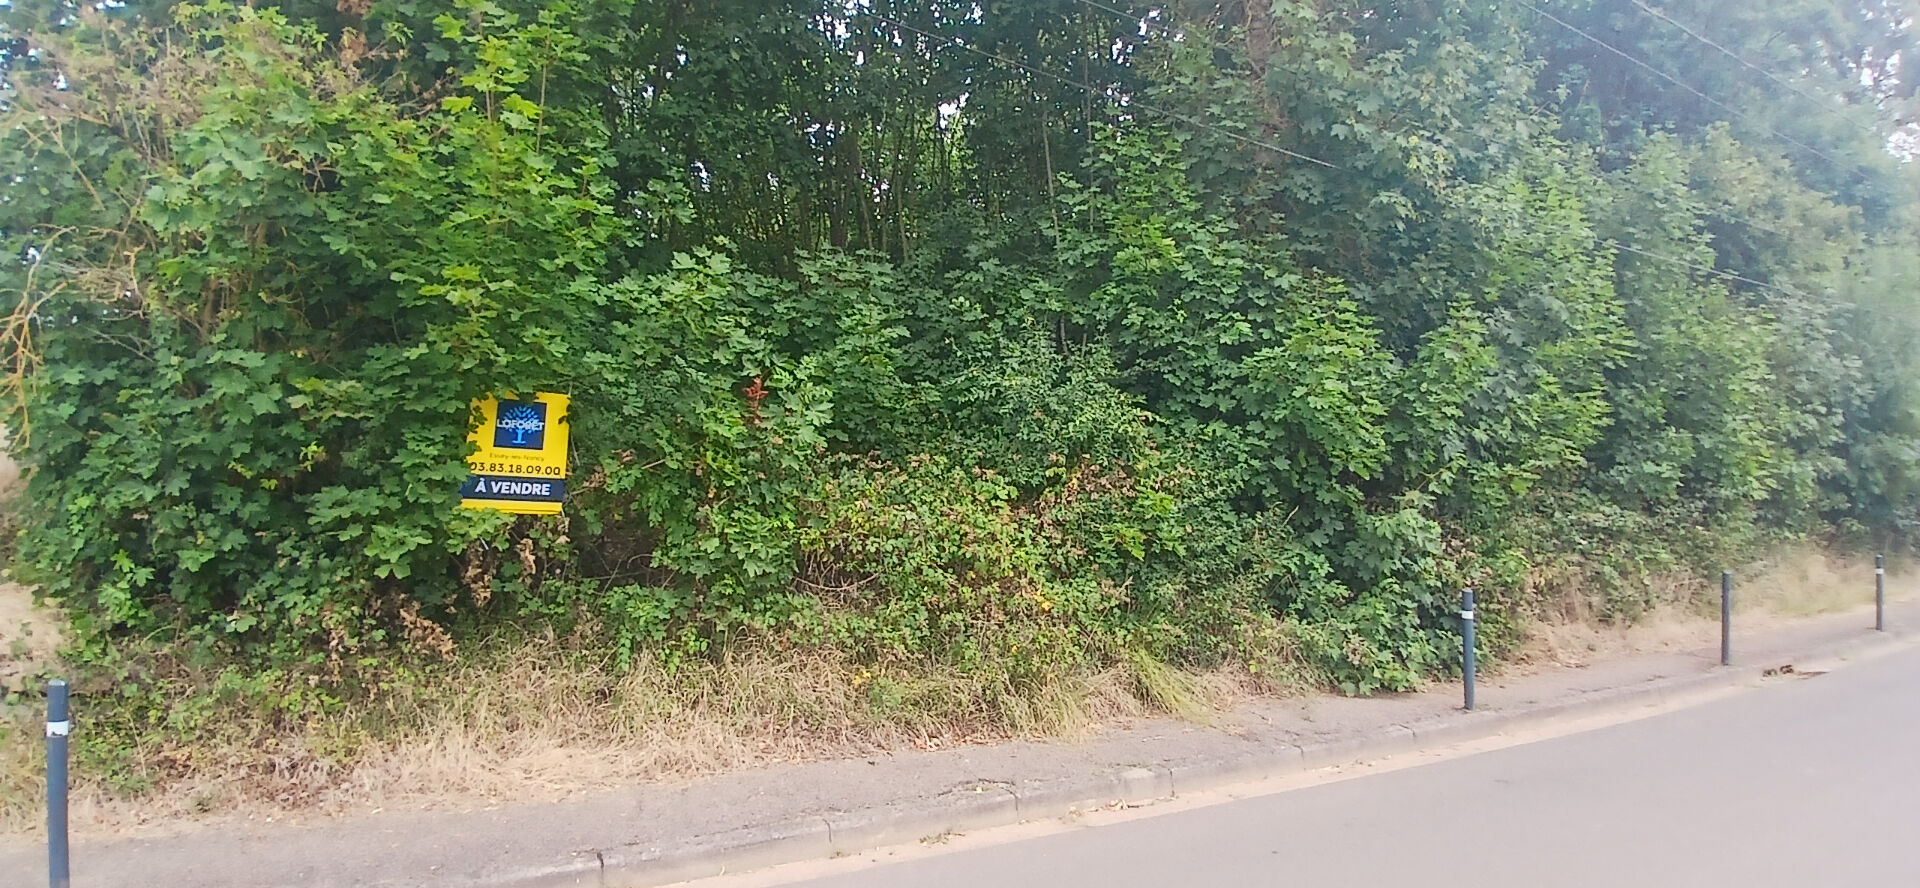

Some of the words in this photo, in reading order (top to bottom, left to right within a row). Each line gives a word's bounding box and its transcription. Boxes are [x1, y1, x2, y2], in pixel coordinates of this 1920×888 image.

[470, 462, 561, 475] 03.83.18.09.00
[474, 478, 487, 493] À
[491, 481, 551, 496] VENDRE
